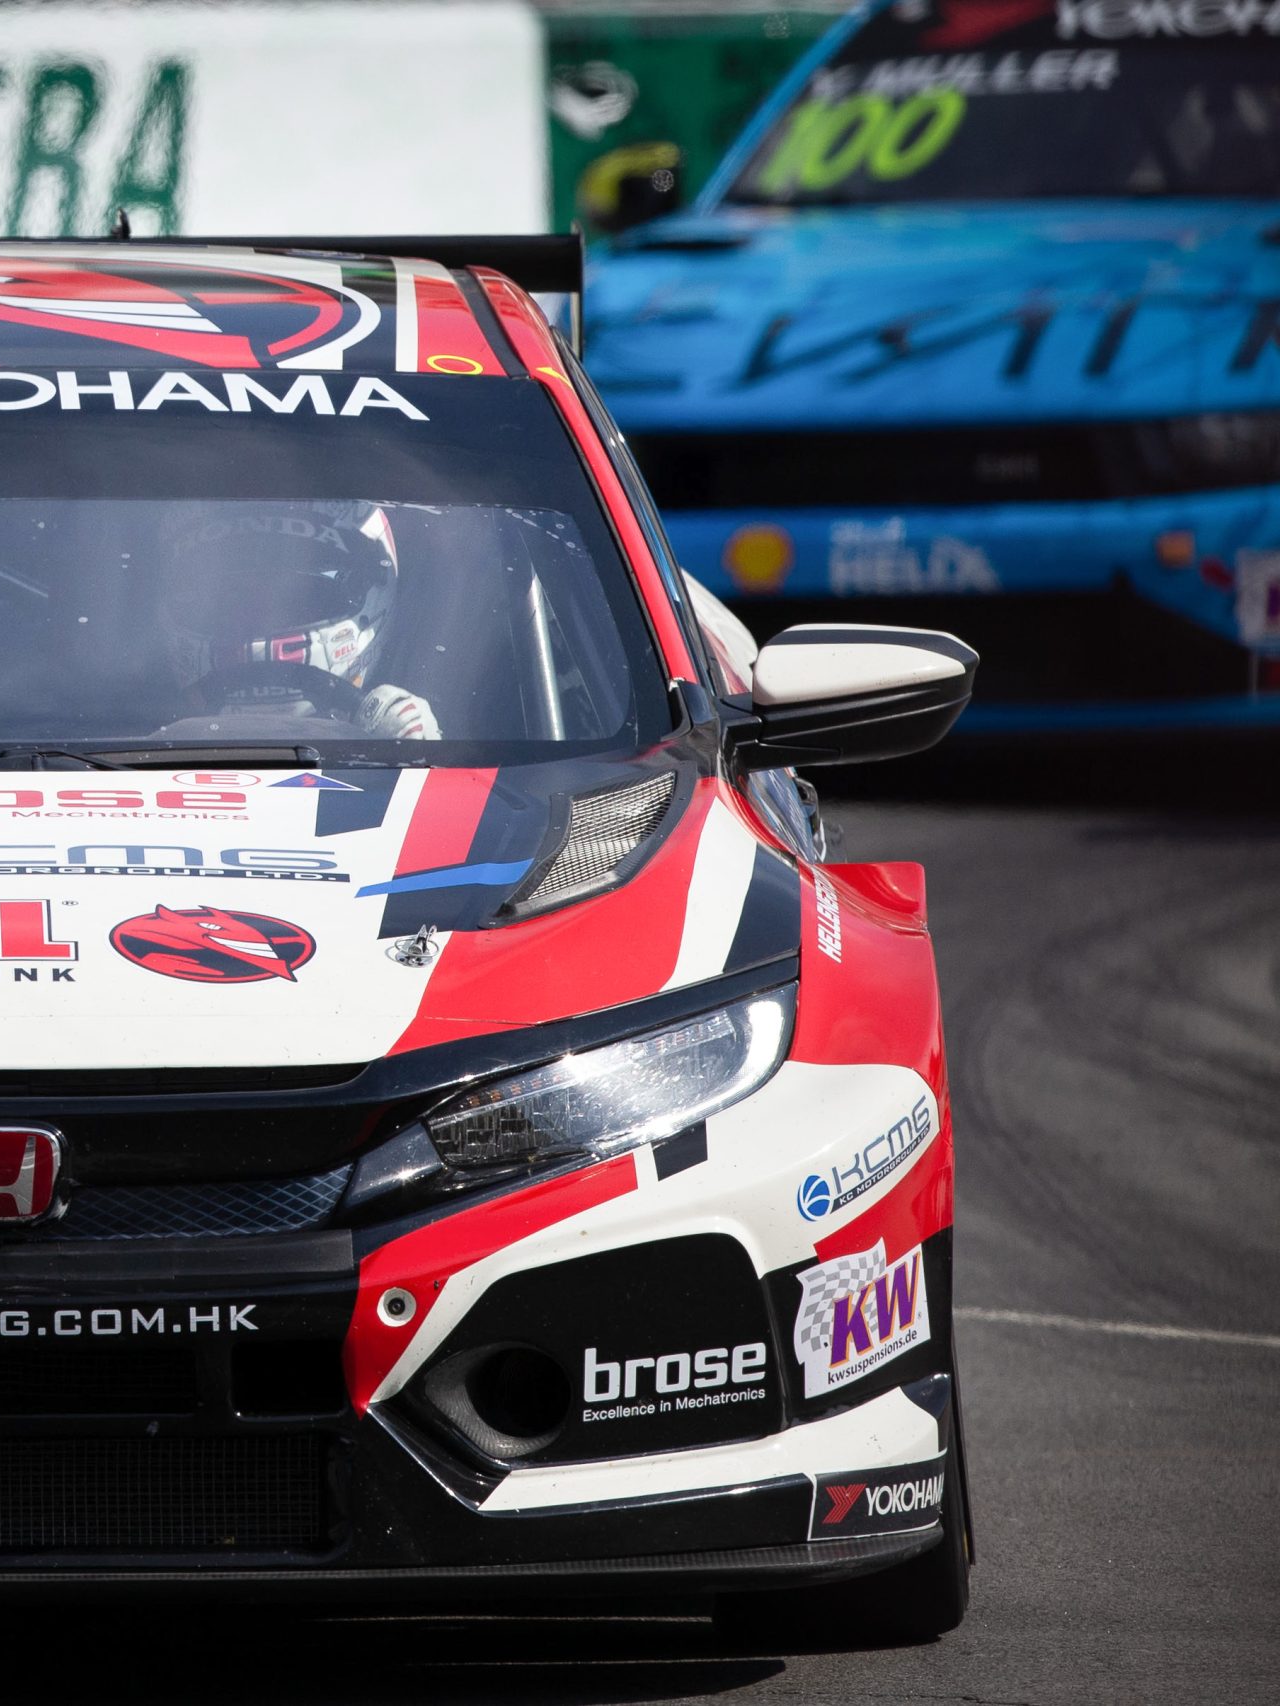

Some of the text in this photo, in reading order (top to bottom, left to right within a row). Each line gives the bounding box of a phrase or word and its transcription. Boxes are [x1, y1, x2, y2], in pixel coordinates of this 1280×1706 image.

[758, 87, 967, 193] 100
[12, 811, 249, 821] Mechatronics
[245, 870, 336, 881] LTD.
[831, 1095, 930, 1194] KCMG
[840, 1191, 854, 1206] KC
[856, 1142, 918, 1195] MOTORGROUP
[830, 1251, 920, 1369] KW
[583, 1342, 767, 1403] brose
[828, 1329, 917, 1385] kwsuspensions.de
[583, 1388, 766, 1422] Excellence in Mechatronics
